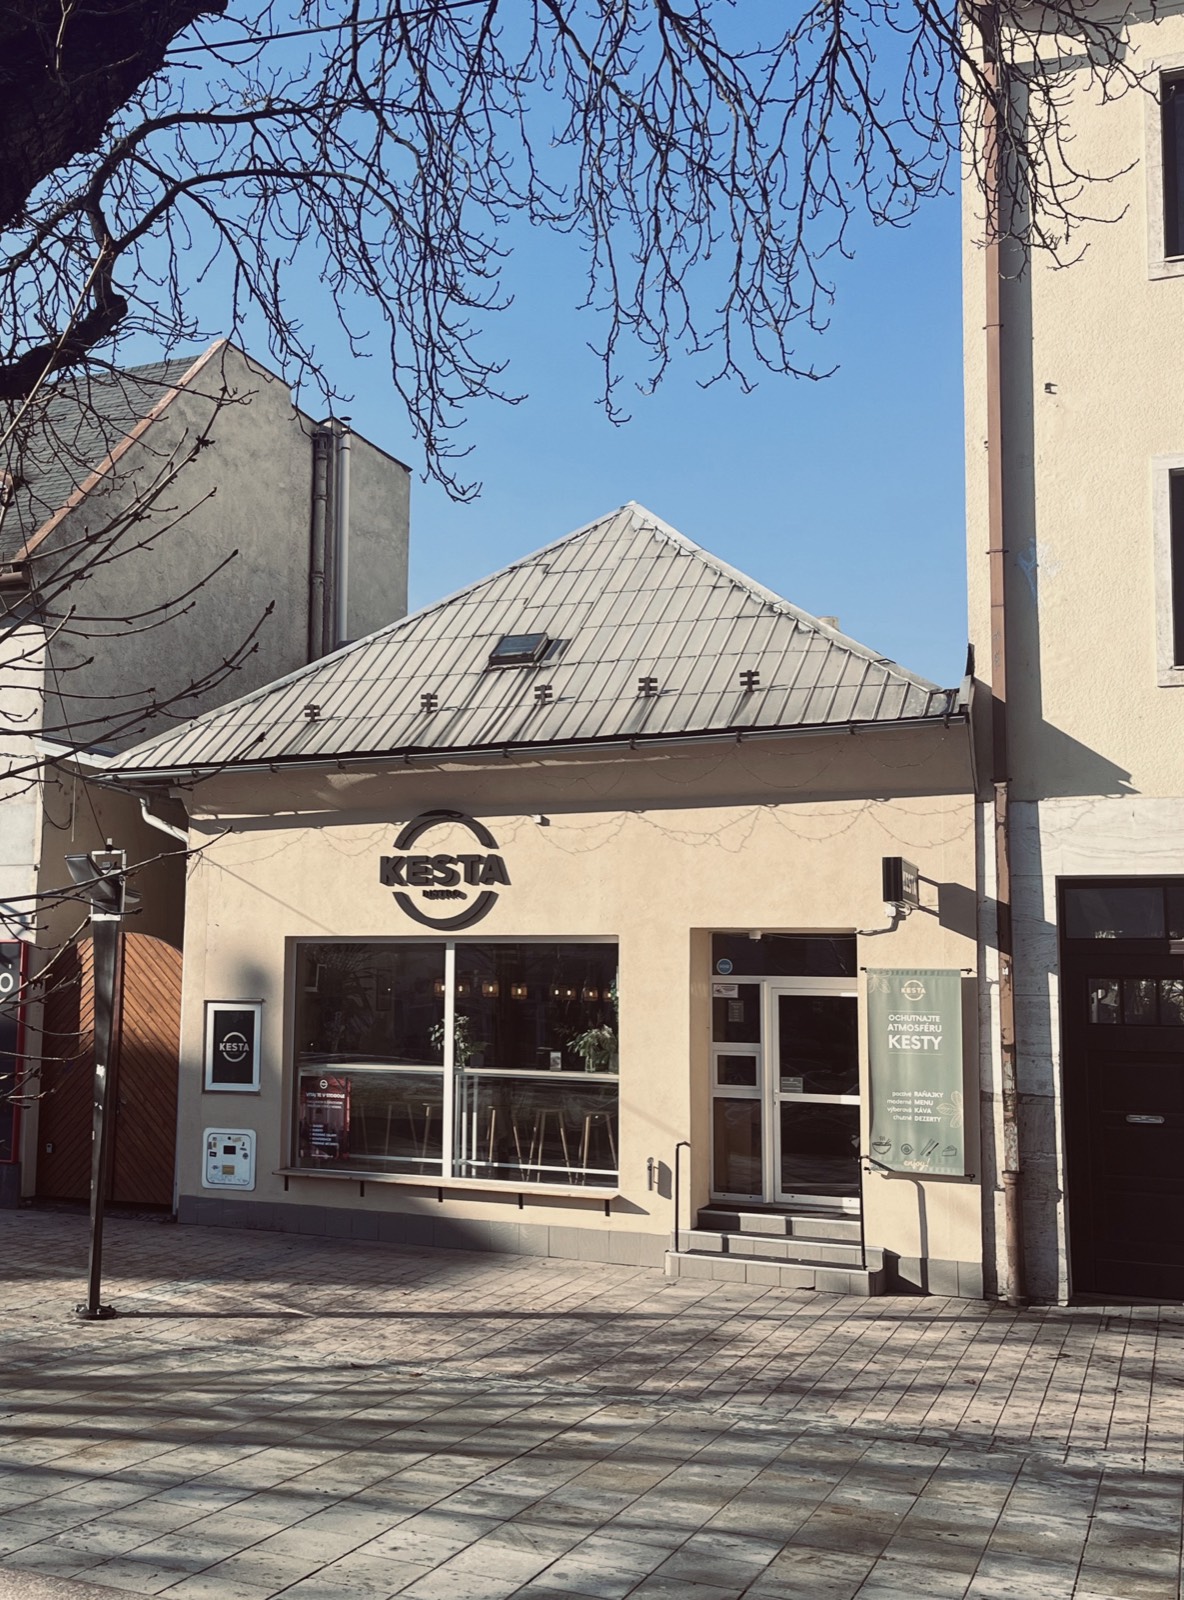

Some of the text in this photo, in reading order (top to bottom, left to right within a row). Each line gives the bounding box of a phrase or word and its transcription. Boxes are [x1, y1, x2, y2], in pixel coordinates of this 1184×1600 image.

[380, 854, 512, 887] KESTA
[888, 1014, 941, 1023] OCHUTNAJTE
[887, 1023, 942, 1032] ATMOSFÉRU
[219, 1042, 250, 1051] KESTA
[888, 1034, 942, 1050] KESTY
[913, 1090, 944, 1098] RAŇAJKY
